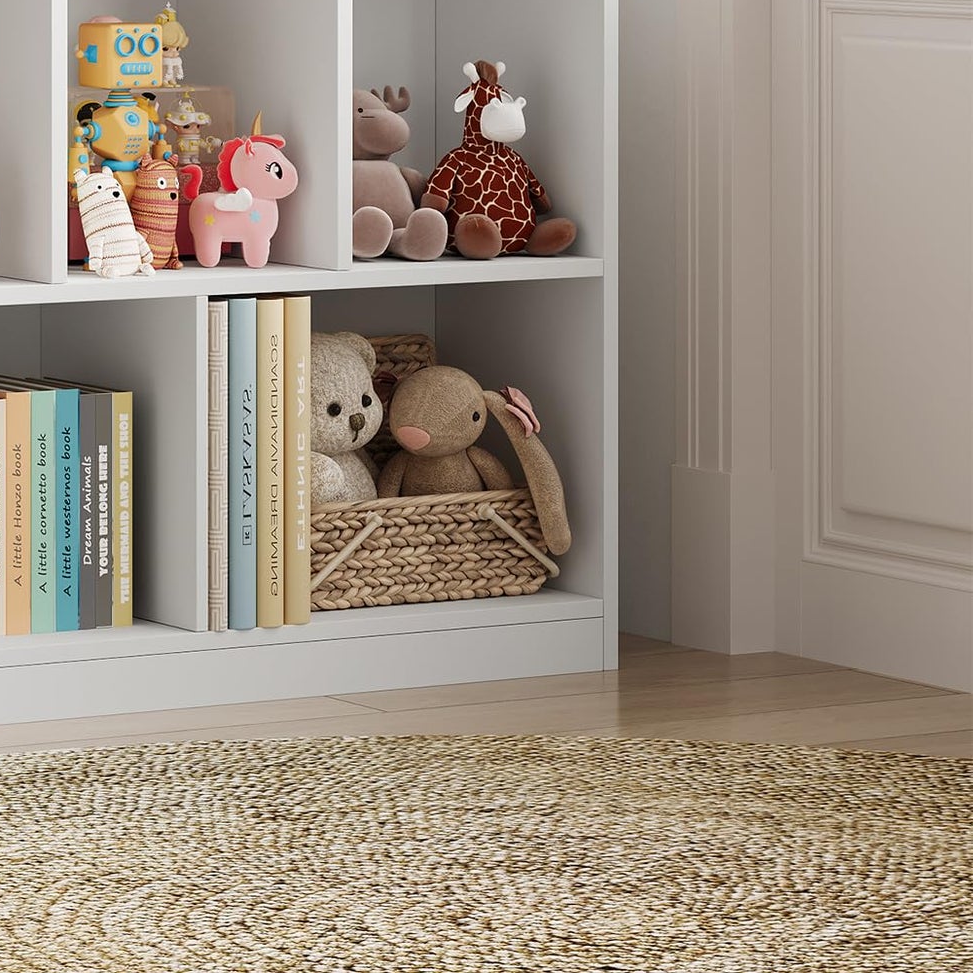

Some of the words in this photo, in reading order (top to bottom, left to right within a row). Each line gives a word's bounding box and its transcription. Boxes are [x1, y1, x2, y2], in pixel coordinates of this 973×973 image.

[12, 444, 22, 477] book
[37, 434, 47, 467] book
[61, 427, 71, 460] book
[98, 445, 108, 481] HERE
[82, 456, 92, 514] Animals
[39, 474, 47, 536] cornetto
[63, 466, 71, 539] westernos
[98, 483, 109, 536] BELONG
[12, 534, 22, 568] little
[38, 541, 47, 576] little
[83, 518, 92, 566] Dream
[99, 538, 109, 577] YOUR
[62, 545, 71, 579] little
[14, 575, 22, 587] A
[39, 582, 47, 594] A
[63, 585, 72, 597] A
